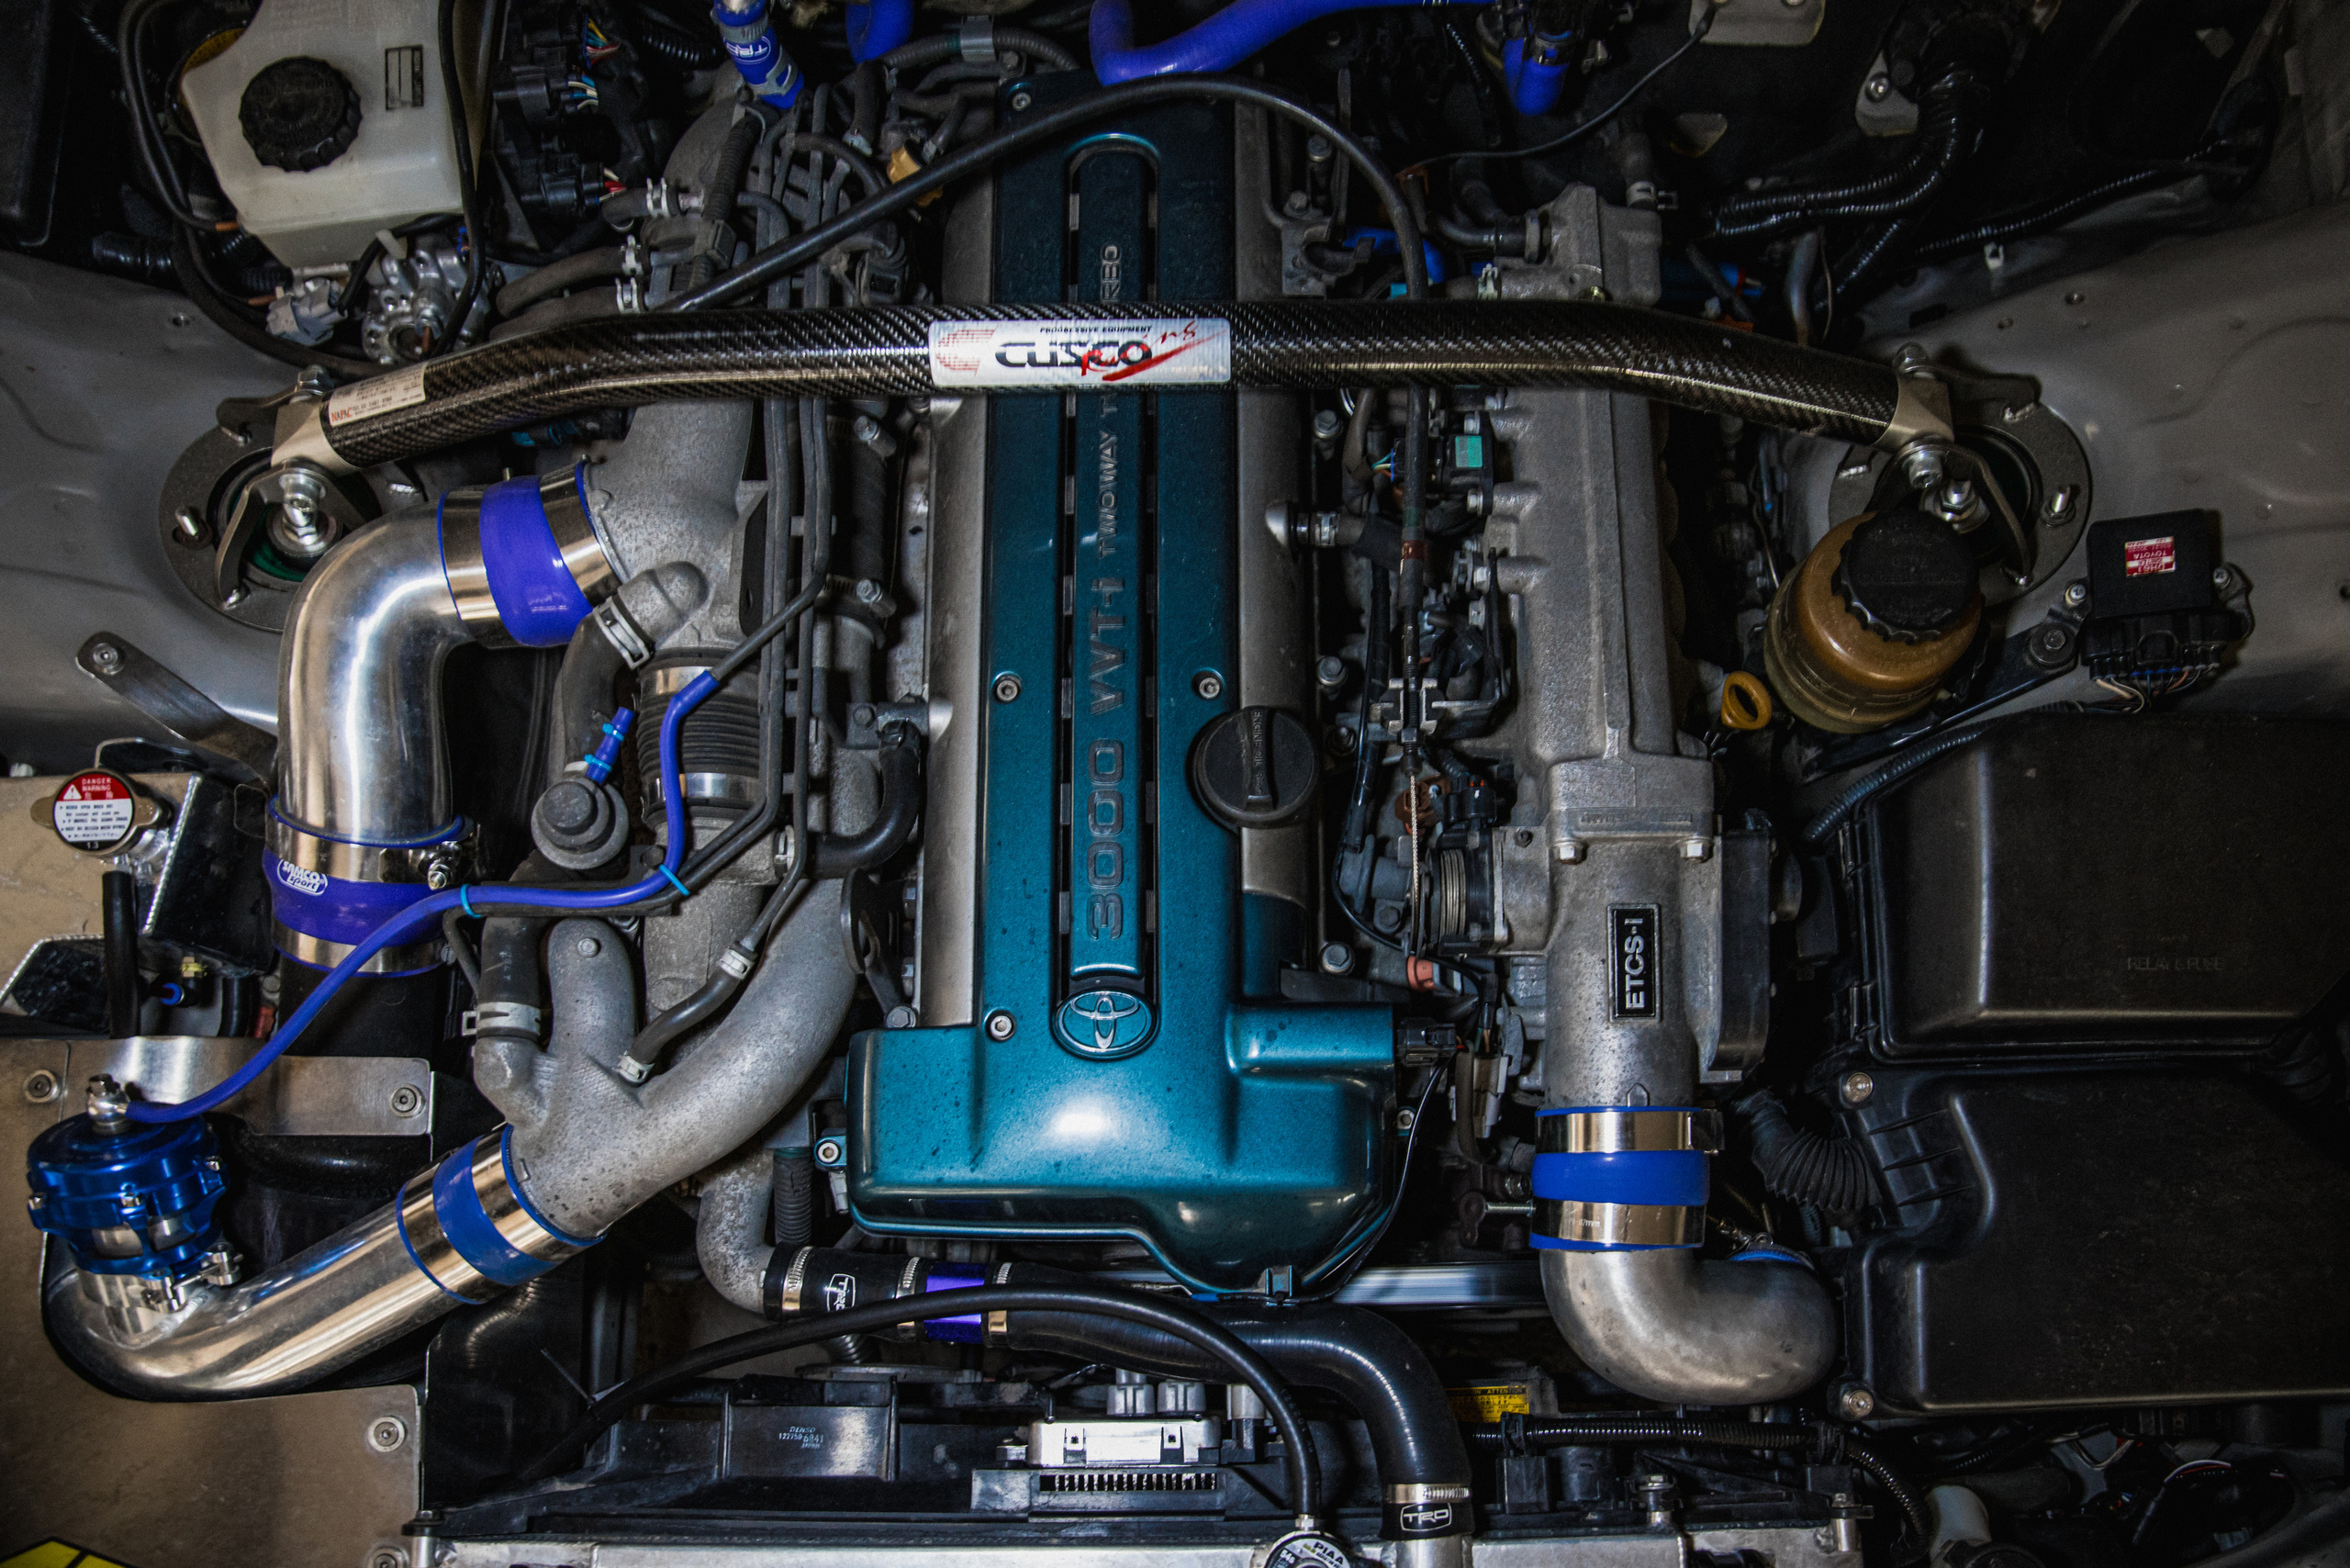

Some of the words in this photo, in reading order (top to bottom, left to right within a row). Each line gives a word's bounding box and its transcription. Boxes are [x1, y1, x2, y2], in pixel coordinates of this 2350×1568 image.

[726, 42, 769, 59] TRD
[1100, 241, 1123, 304] RBO
[1039, 325, 1100, 333] PROGRESSIVE
[1102, 325, 1152, 333] EQUIPMENT
[994, 340, 1154, 368] CUSCO
[331, 407, 352, 422] NAPAC
[1098, 429, 1118, 487] WAY
[1096, 489, 1118, 559] TWO
[2133, 549, 2167, 559] TOYOTA
[81, 778, 113, 786] DANGER
[81, 784, 112, 792] WARNING
[1086, 737, 1125, 942] 3000
[281, 860, 321, 882] SAMCO
[1403, 1508, 1449, 1525] TRD
[1314, 1540, 1344, 1565] PIAA
